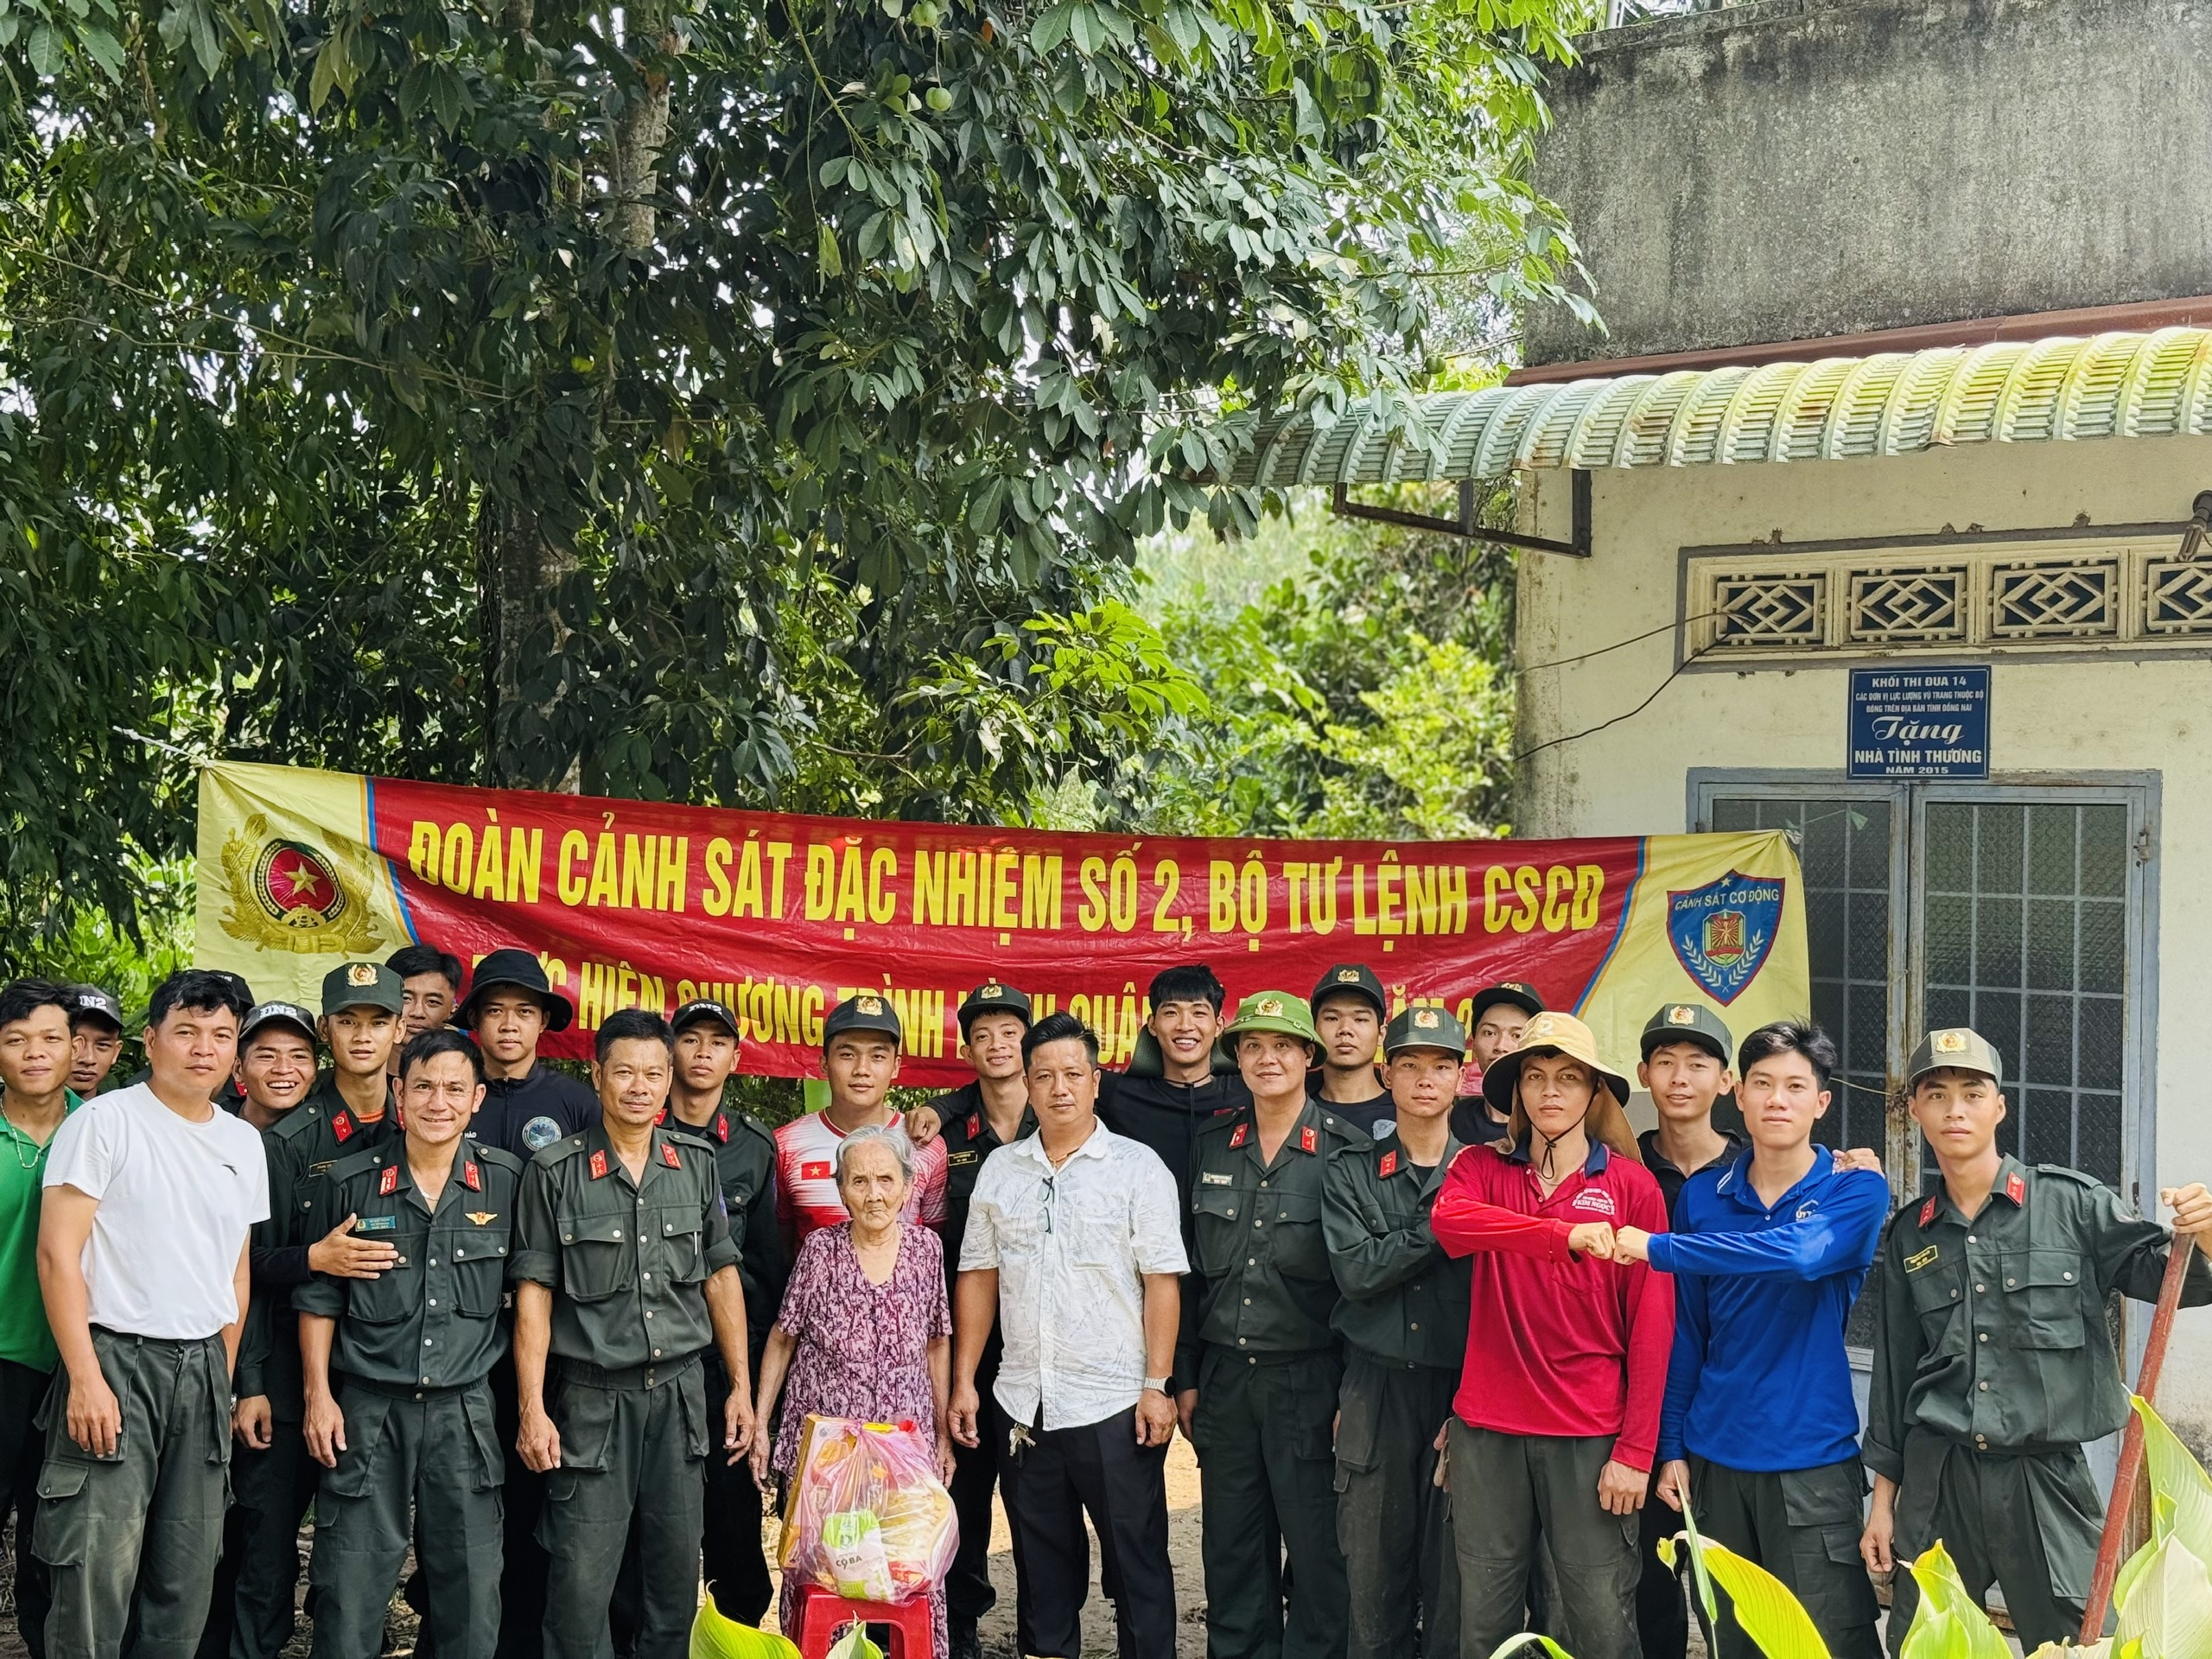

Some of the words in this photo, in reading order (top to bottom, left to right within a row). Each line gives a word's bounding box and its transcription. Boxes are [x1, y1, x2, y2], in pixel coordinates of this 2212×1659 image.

[1872, 675, 1899, 688] KHỐI
[1903, 677, 1921, 687] THI
[1925, 677, 1948, 686] ĐUA
[1952, 677, 1967, 686] 14
[1856, 691, 1867, 701] CÁC
[1933, 691, 1953, 700] TRANG
[1955, 690, 1974, 701] THUỘC
[1872, 716, 1964, 746] Tặng
[1855, 748, 1884, 763] NHÀ
[1887, 748, 1920, 763] TÌNH
[1924, 748, 1982, 763] THƯƠNG
[407, 807, 543, 904] ĐOÀN
[557, 811, 688, 912] CẢNH
[702, 829, 793, 919] SÁT
[804, 834, 898, 941] ĐẶC
[912, 847, 1064, 946] NHIỆM
[1078, 842, 1143, 933] SỐ
[1153, 859, 1192, 943] 2,
[1209, 849, 1268, 951] BỘ
[1282, 855, 1342, 935] TƯ
[1353, 850, 1468, 952] LỆNH
[1484, 864, 1606, 934] CSCĐ
[1675, 896, 1702, 911] CẢNH
[1704, 891, 1726, 906] SÁT
[1729, 890, 1748, 904] CƠ
[1749, 887, 1779, 905] ĐỘNG
[79, 995, 107, 1009] N2
